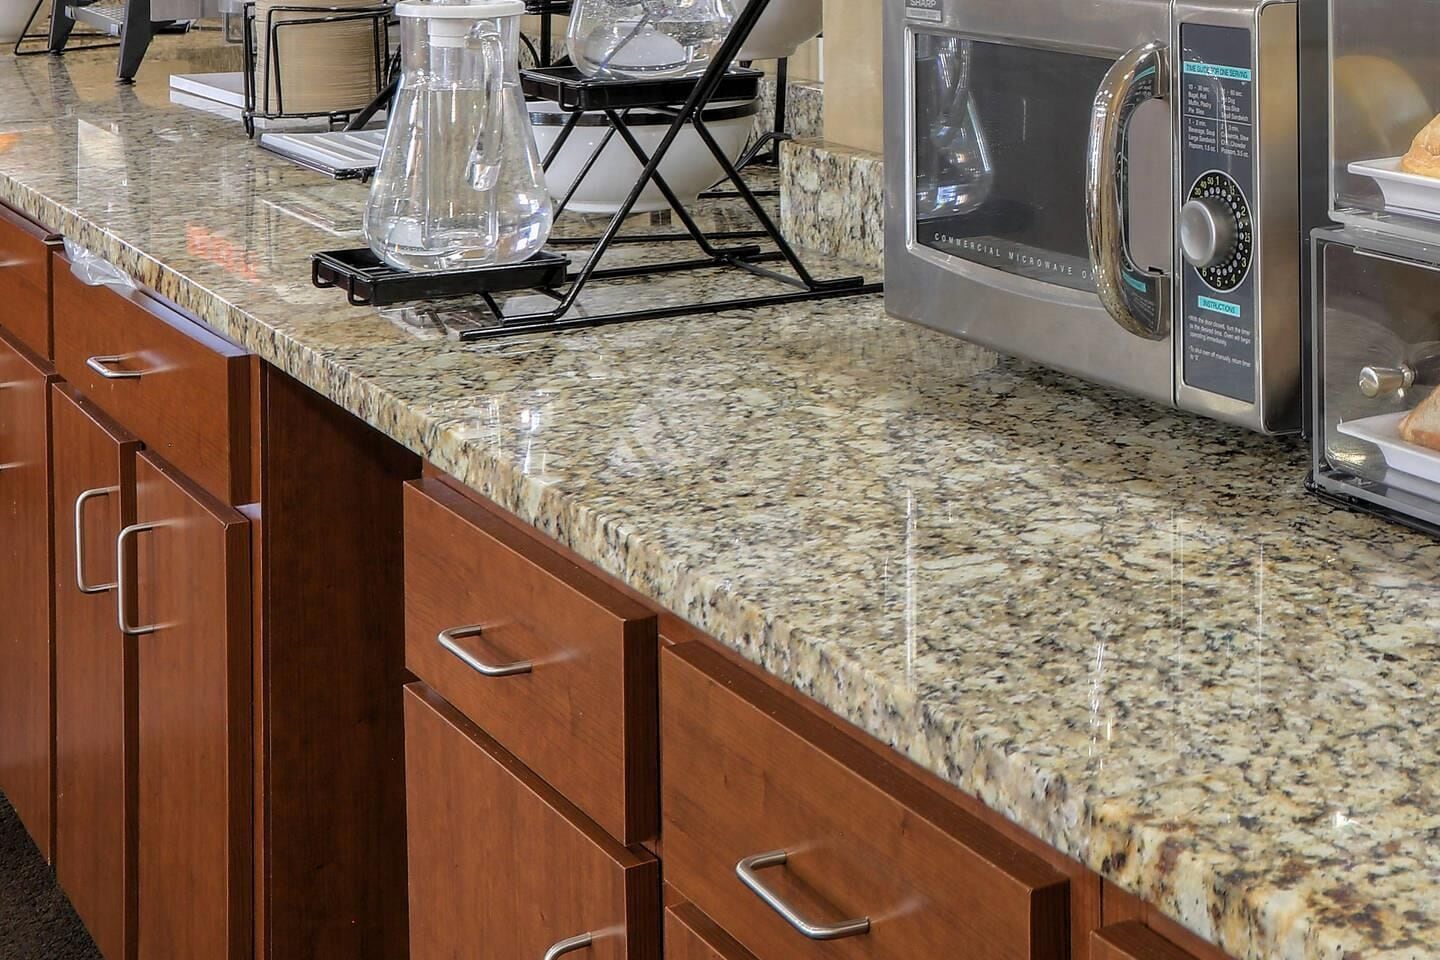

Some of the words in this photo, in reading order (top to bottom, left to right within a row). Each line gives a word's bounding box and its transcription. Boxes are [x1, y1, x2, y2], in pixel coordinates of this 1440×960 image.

[1240, 206, 1246, 216] 2
[934, 232, 1001, 257] COMMERCIAL
[1008, 251, 1073, 275] MICROWAVE
[1241, 257, 1247, 267] 3
[1216, 277, 1222, 287] 5
[1231, 273, 1236, 284] 4
